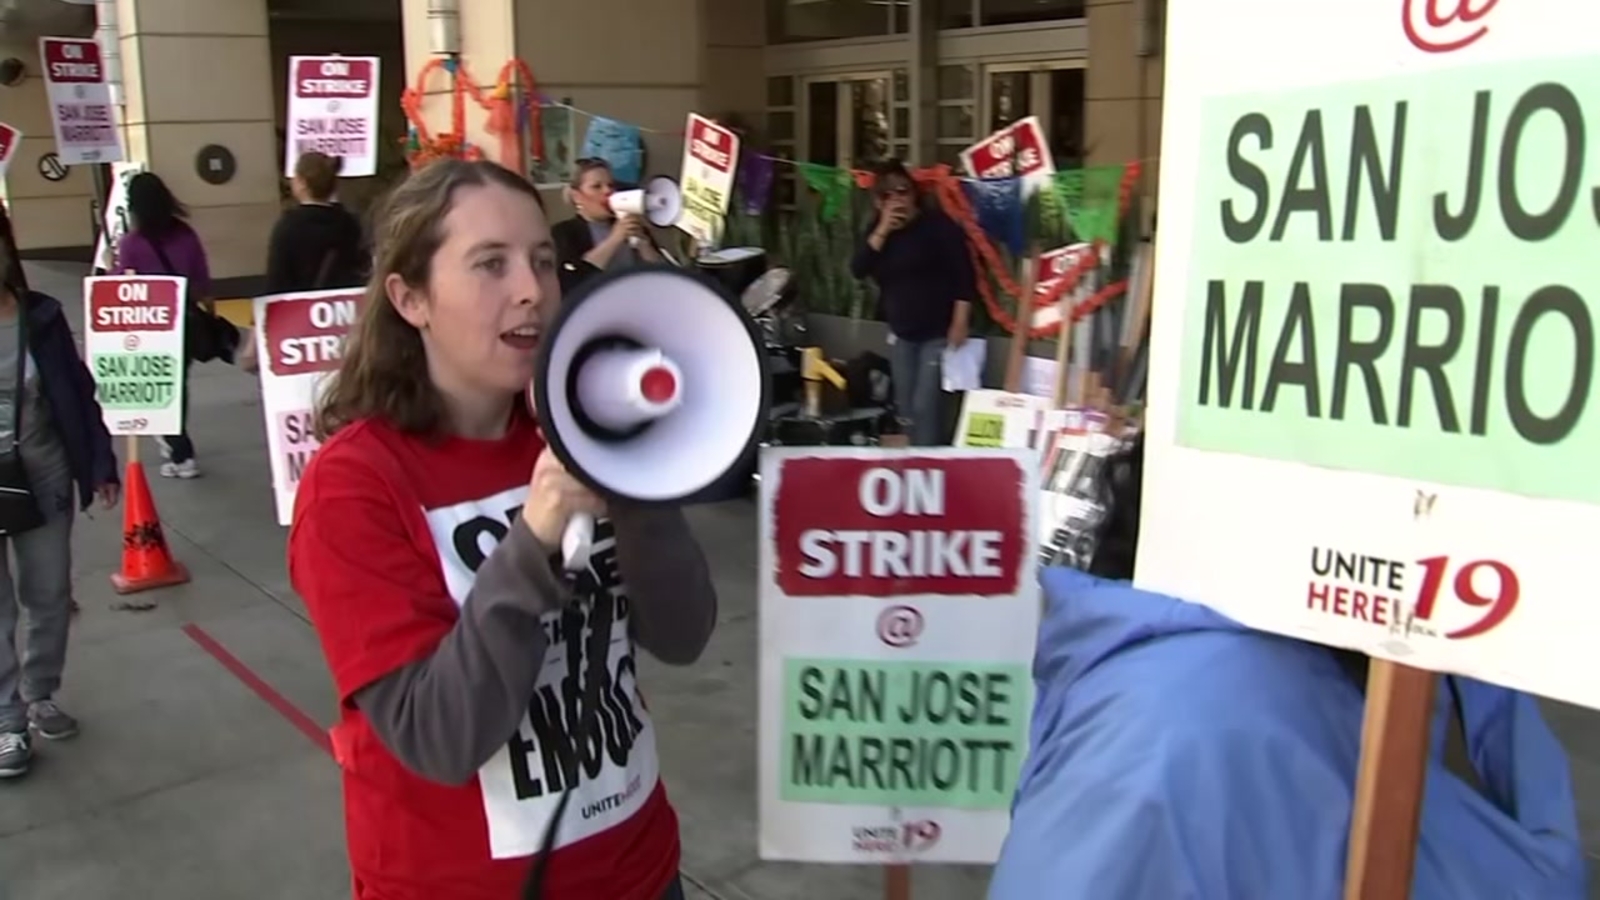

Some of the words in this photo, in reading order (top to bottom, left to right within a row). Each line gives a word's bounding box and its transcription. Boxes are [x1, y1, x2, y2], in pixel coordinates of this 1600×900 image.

[51, 62, 99, 77] STRIKE
[320, 62, 349, 76] ON
[301, 79, 367, 93] STRIKE
[297, 119, 325, 135] SAN
[329, 118, 366, 134] JOSE
[1219, 100, 1408, 245] SAN
[1432, 81, 1600, 243] JO
[117, 283, 148, 302] ON
[97, 306, 170, 326] STRIKE
[309, 301, 357, 329] ON
[97, 356, 126, 378] SAN
[130, 355, 172, 377] JOSE
[97, 381, 174, 404] MARRIOTT
[858, 467, 944, 516] ON
[798, 529, 1003, 579] STRIKE
[1311, 546, 1405, 592] UNITE
[1415, 554, 1520, 640] 19
[876, 604, 924, 648] @
[797, 666, 886, 724] SAN
[898, 669, 1011, 726] JOSE
[791, 732, 1013, 793] MARRIOTT
[902, 819, 942, 853] 19
